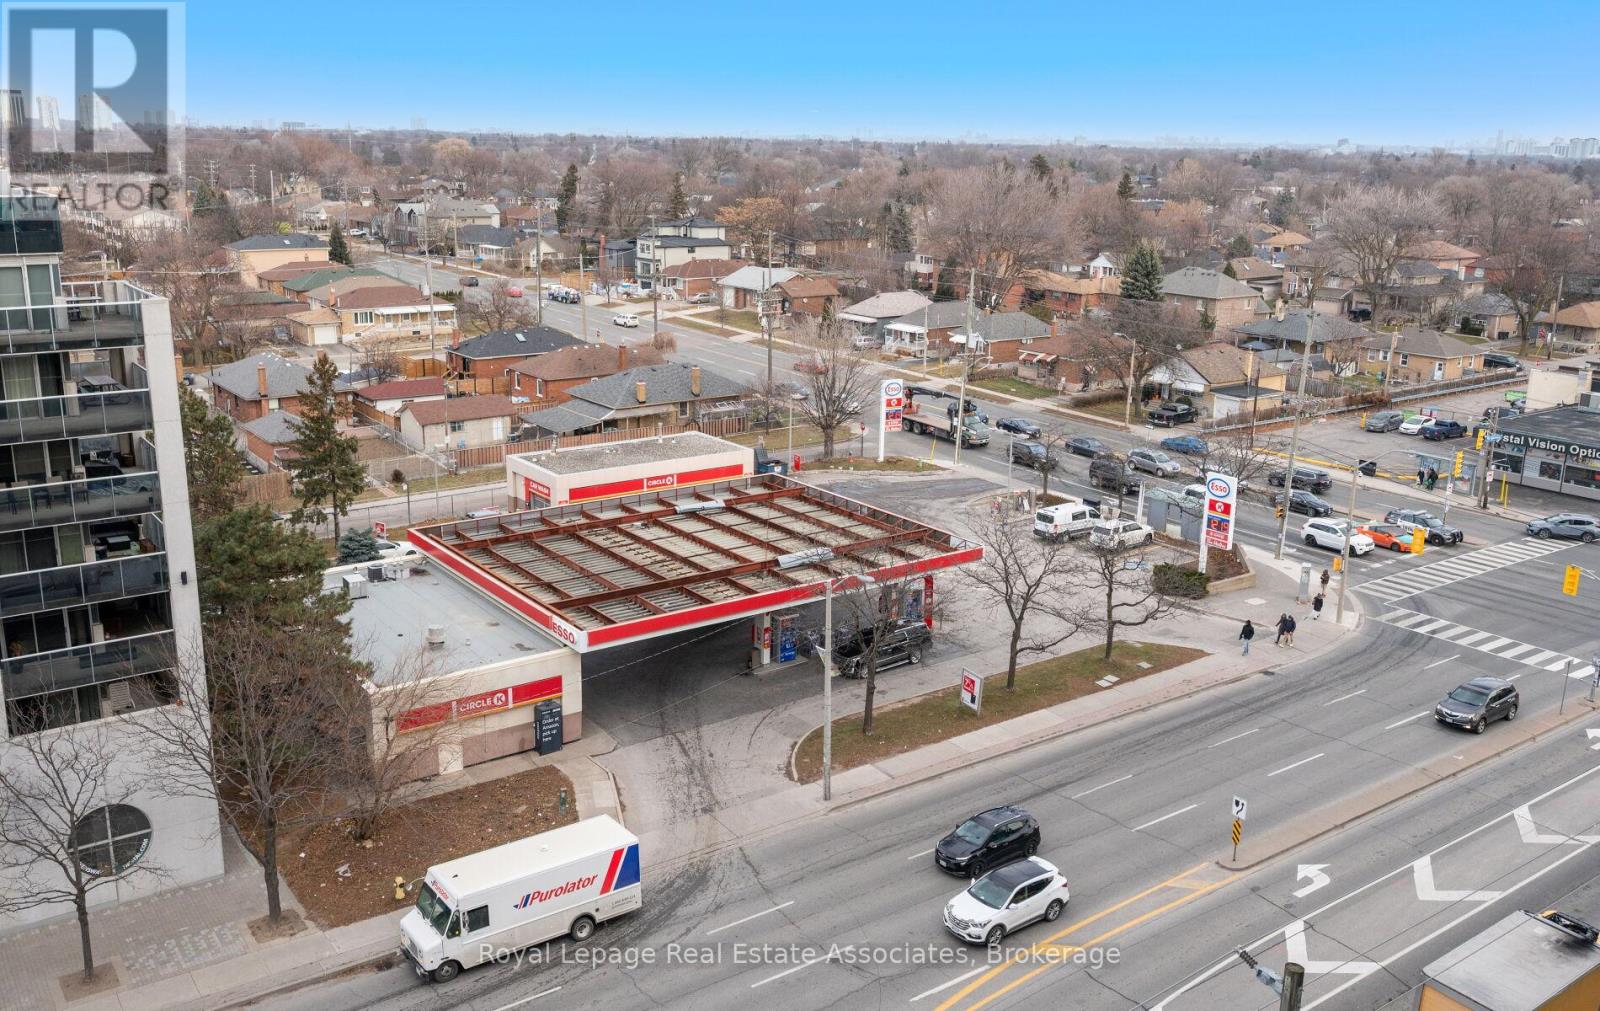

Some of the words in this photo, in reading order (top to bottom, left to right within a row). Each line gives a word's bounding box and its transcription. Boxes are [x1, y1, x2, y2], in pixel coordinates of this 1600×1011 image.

[1527, 437, 1565, 452] Vision
[460, 698, 492, 712] CIRCLE
[495, 694, 504, 705] K
[529, 873, 598, 906] Purolator
